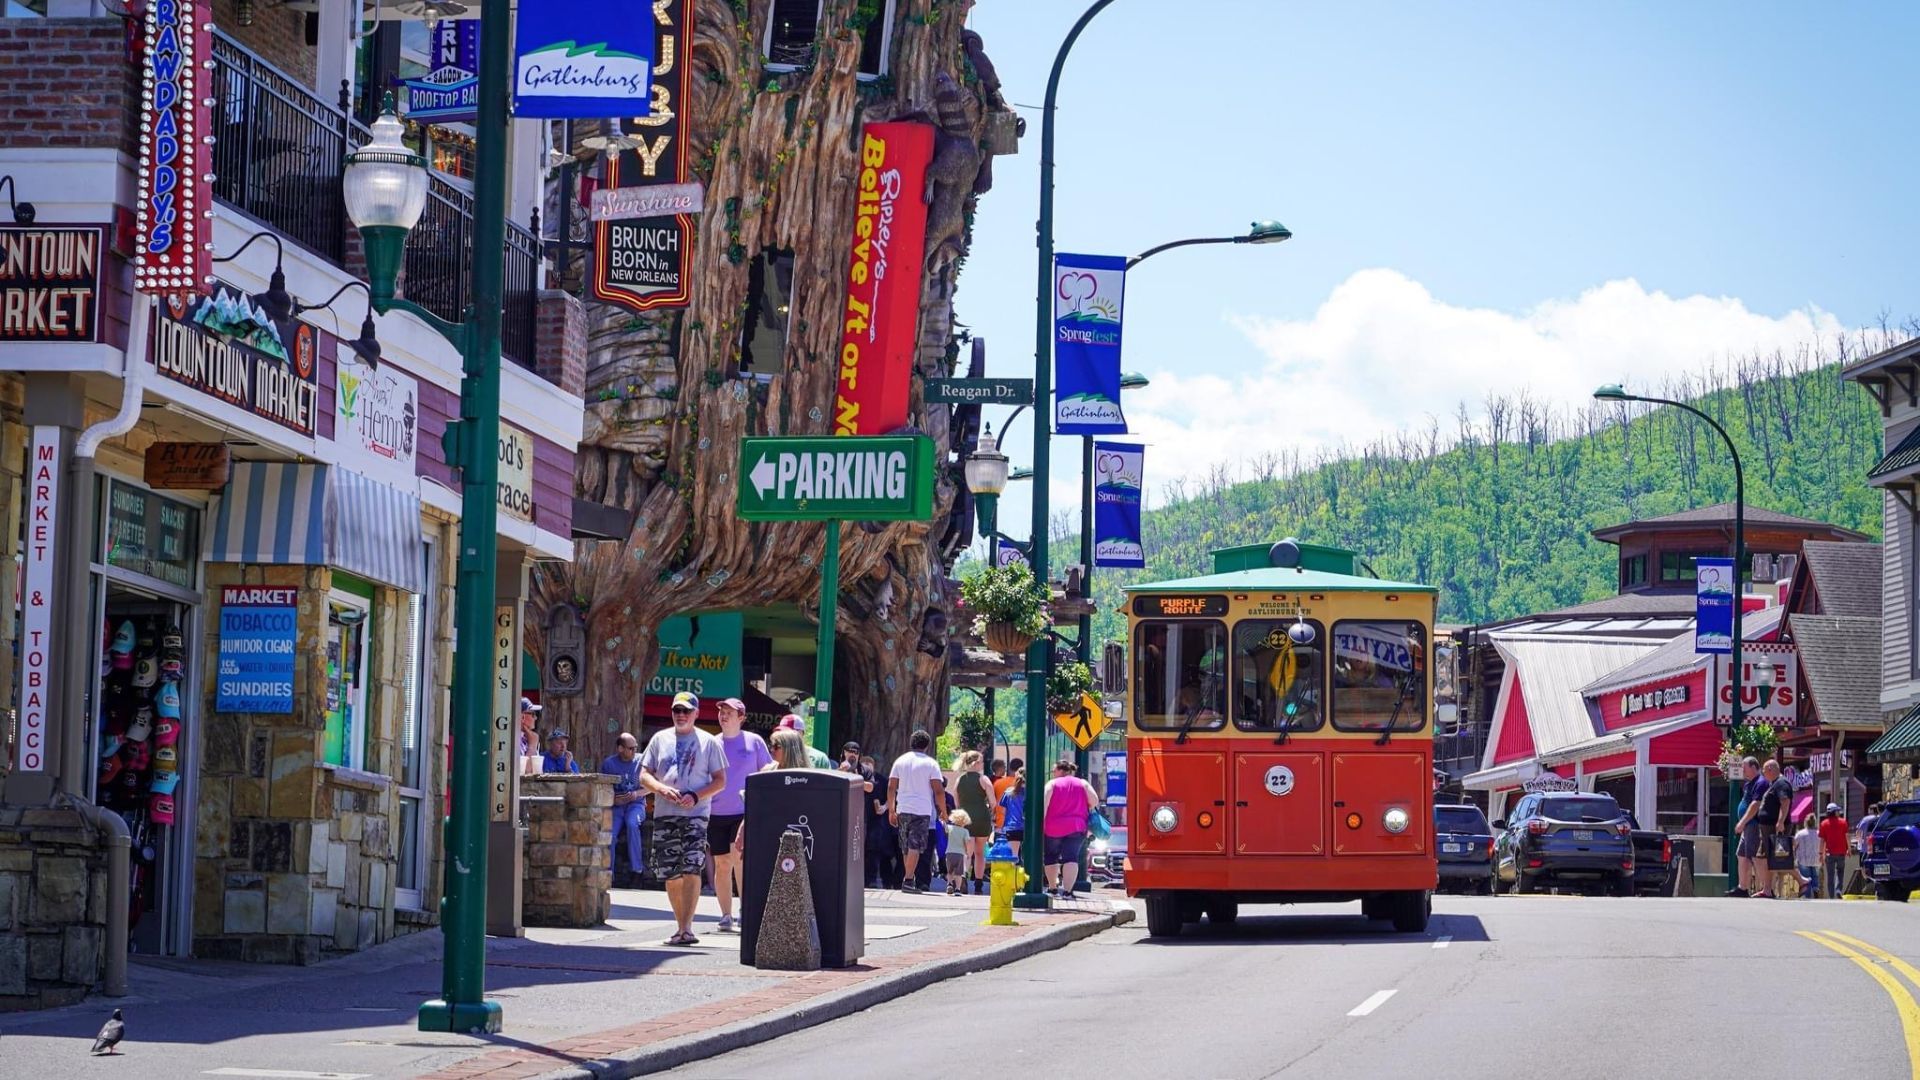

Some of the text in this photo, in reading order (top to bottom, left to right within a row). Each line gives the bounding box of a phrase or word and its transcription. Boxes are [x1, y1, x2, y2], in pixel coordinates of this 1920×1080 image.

[433, 69, 463, 83] SALOON
[524, 64, 640, 95] Gatlinburg
[412, 84, 479, 110] ROOFTOP BA
[602, 191, 693, 217] Sunshine
[851, 133, 886, 286] Believe
[612, 225, 679, 253] BRUNCH
[611, 249, 670, 271] BORN in
[611, 268, 679, 285] NEW ORLEANS
[846, 294, 869, 335] It
[158, 315, 319, 434] DOWNTOWN MARKET
[840, 341, 860, 391] or
[941, 384, 1016, 400] Reagan Dr.
[1061, 405, 1121, 421] Gatlinburg
[361, 397, 405, 460] Hemp
[498, 434, 525, 471] od's
[777, 450, 907, 500] PARKING
[497, 481, 530, 516] race
[1098, 545, 1140, 558] Gatlinburg
[25, 445, 54, 769] MARKET & TOBACCO
[224, 589, 296, 604] MARKET
[1160, 599, 1207, 608] PURPLE
[1163, 606, 1202, 615] ROUTE
[223, 612, 292, 632] TOBACCO
[220, 639, 294, 653] HUMIDOR CIGAR
[1270, 633, 1287, 645] 22
[666, 652, 729, 671] It or Not!
[221, 682, 292, 697] SUNDRIES
[495, 716, 508, 814] Grace
[1271, 775, 1287, 786] 22
